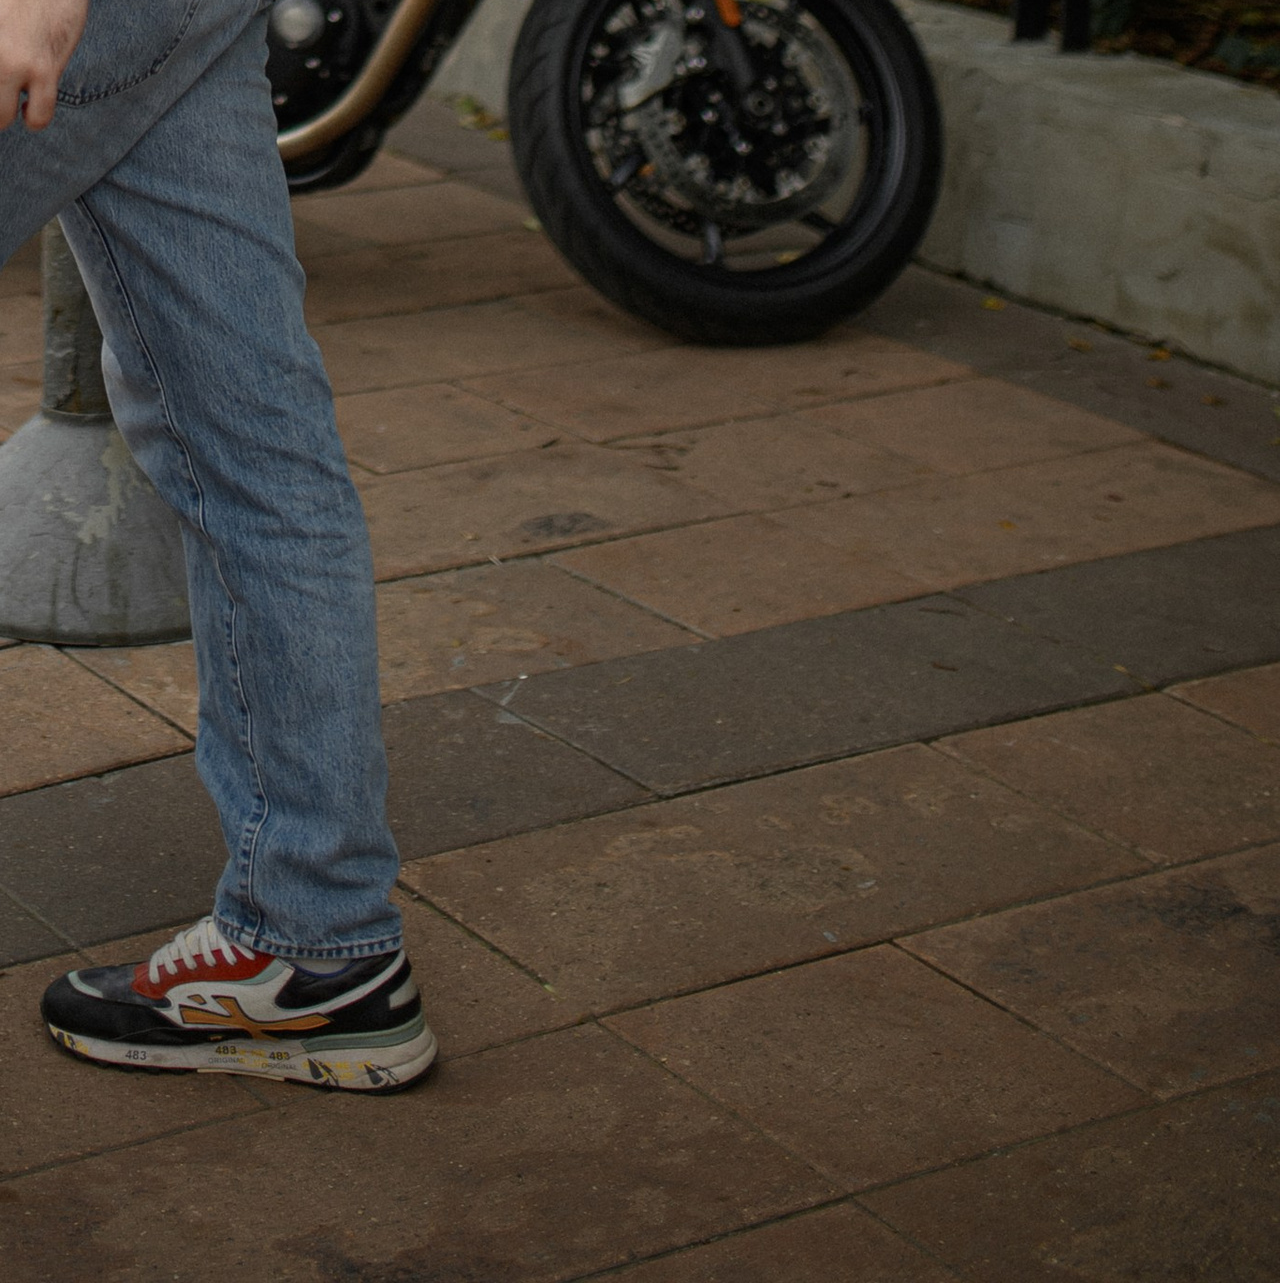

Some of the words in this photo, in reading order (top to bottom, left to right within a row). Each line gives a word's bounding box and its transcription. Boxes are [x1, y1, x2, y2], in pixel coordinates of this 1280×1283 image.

[215, 1045, 237, 1055] 483
[125, 1049, 148, 1062] 483
[269, 1051, 291, 1061] 483
